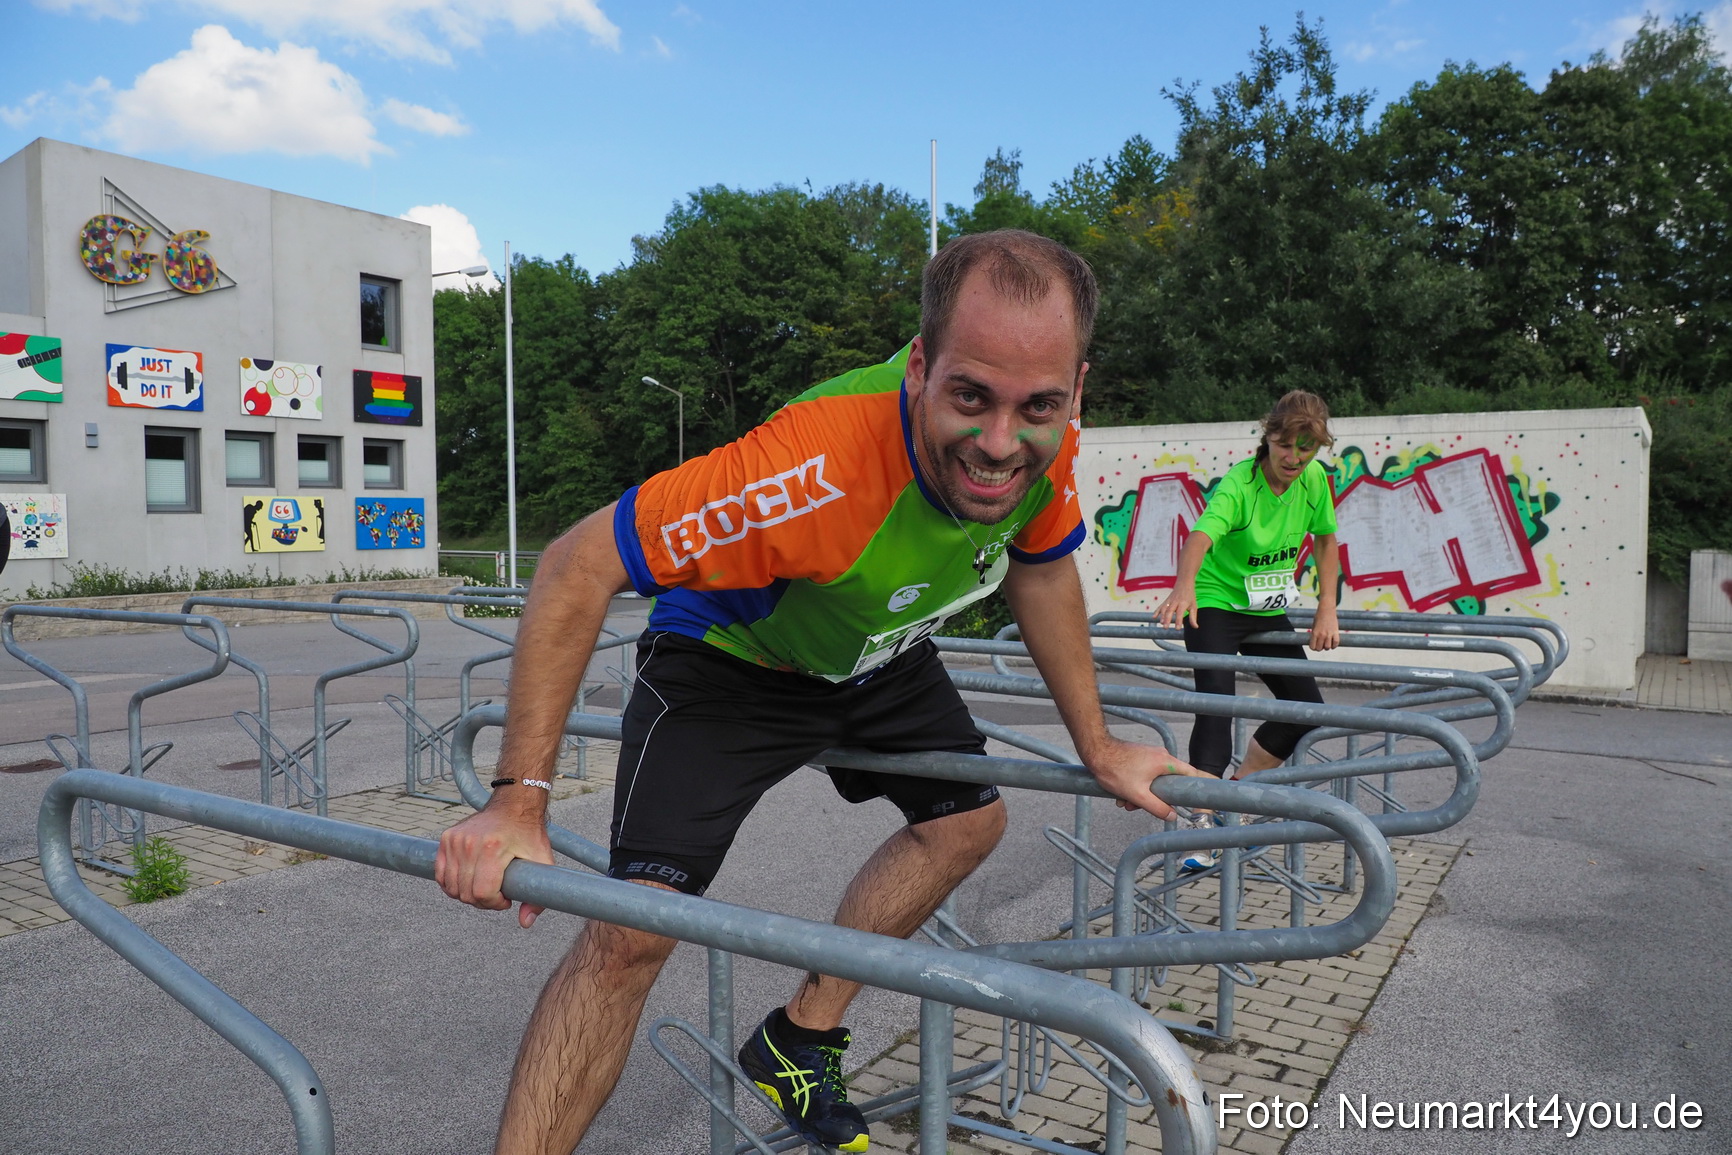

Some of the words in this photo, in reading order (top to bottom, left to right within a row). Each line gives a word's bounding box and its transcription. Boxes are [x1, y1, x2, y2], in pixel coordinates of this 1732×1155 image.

[79, 214, 218, 295] G6
[140, 357, 173, 373] JUST
[141, 383, 157, 398] DO
[161, 384, 173, 399] IT
[660, 454, 846, 569] BOCK
[1248, 547, 1298, 567] BRAND
[644, 862, 689, 883] cep
